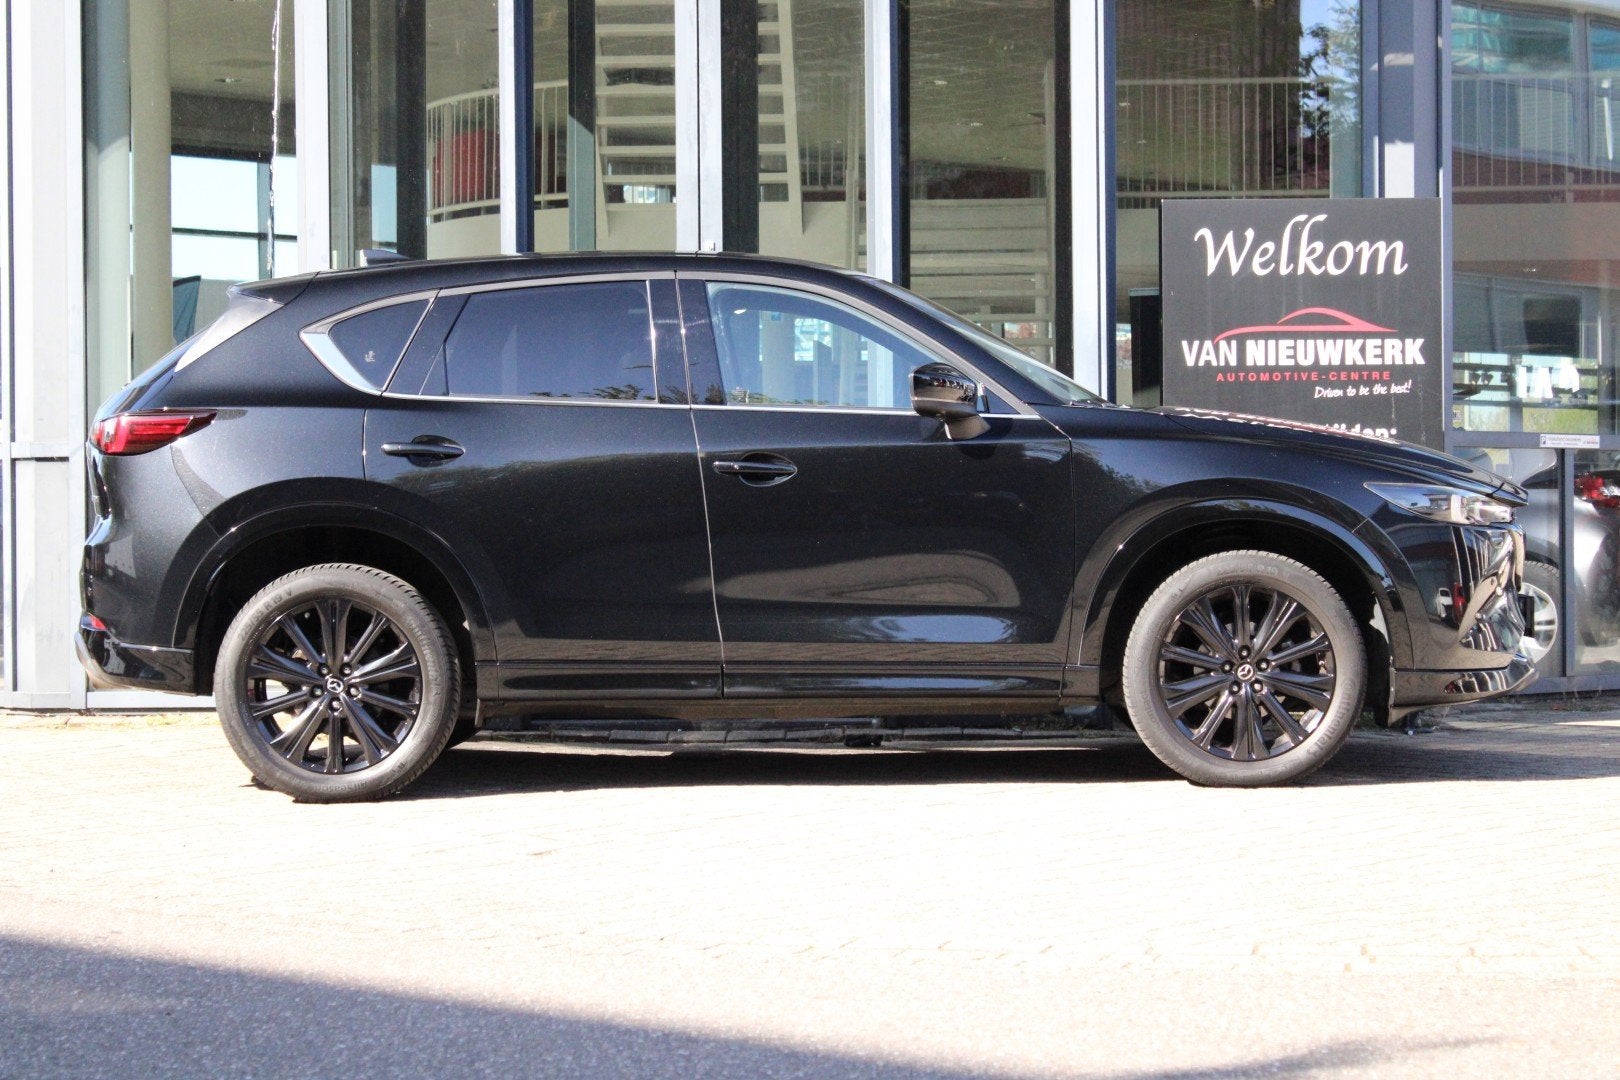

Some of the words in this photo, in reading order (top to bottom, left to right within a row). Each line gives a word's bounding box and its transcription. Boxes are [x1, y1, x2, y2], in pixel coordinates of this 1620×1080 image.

[1194, 213, 1408, 277] Welkom
[1181, 340, 1237, 367] VAN
[1246, 338, 1425, 366] NIEUWKERK
[1216, 371, 1391, 382] AUTOMOTIVE-CENTRE
[1314, 386, 1343, 398] Driven
[1346, 385, 1356, 396] to
[1359, 385, 1369, 396] be
[1372, 383, 1388, 395] the
[1390, 379, 1412, 394] best!
[236, 607, 264, 641] 225/55
[1313, 679, 1356, 751] Continental
